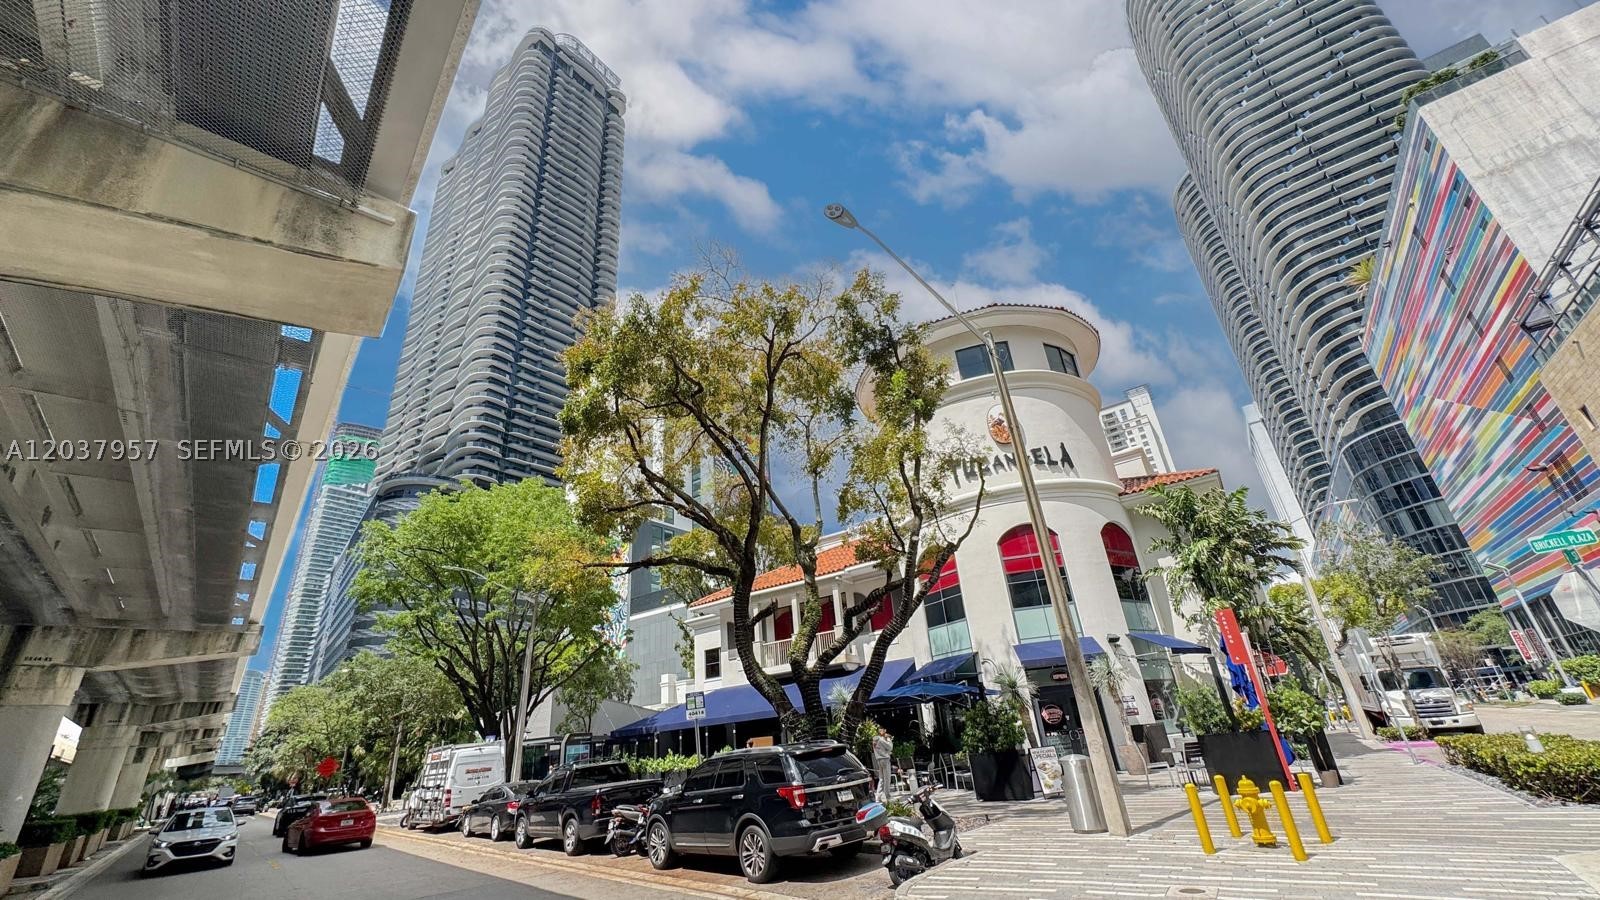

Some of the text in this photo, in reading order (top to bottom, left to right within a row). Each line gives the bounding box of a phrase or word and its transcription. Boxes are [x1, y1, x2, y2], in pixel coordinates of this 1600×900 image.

[1532, 532, 1594, 551] BRICKELL PLAZA
[1219, 612, 1234, 644] PARKING
